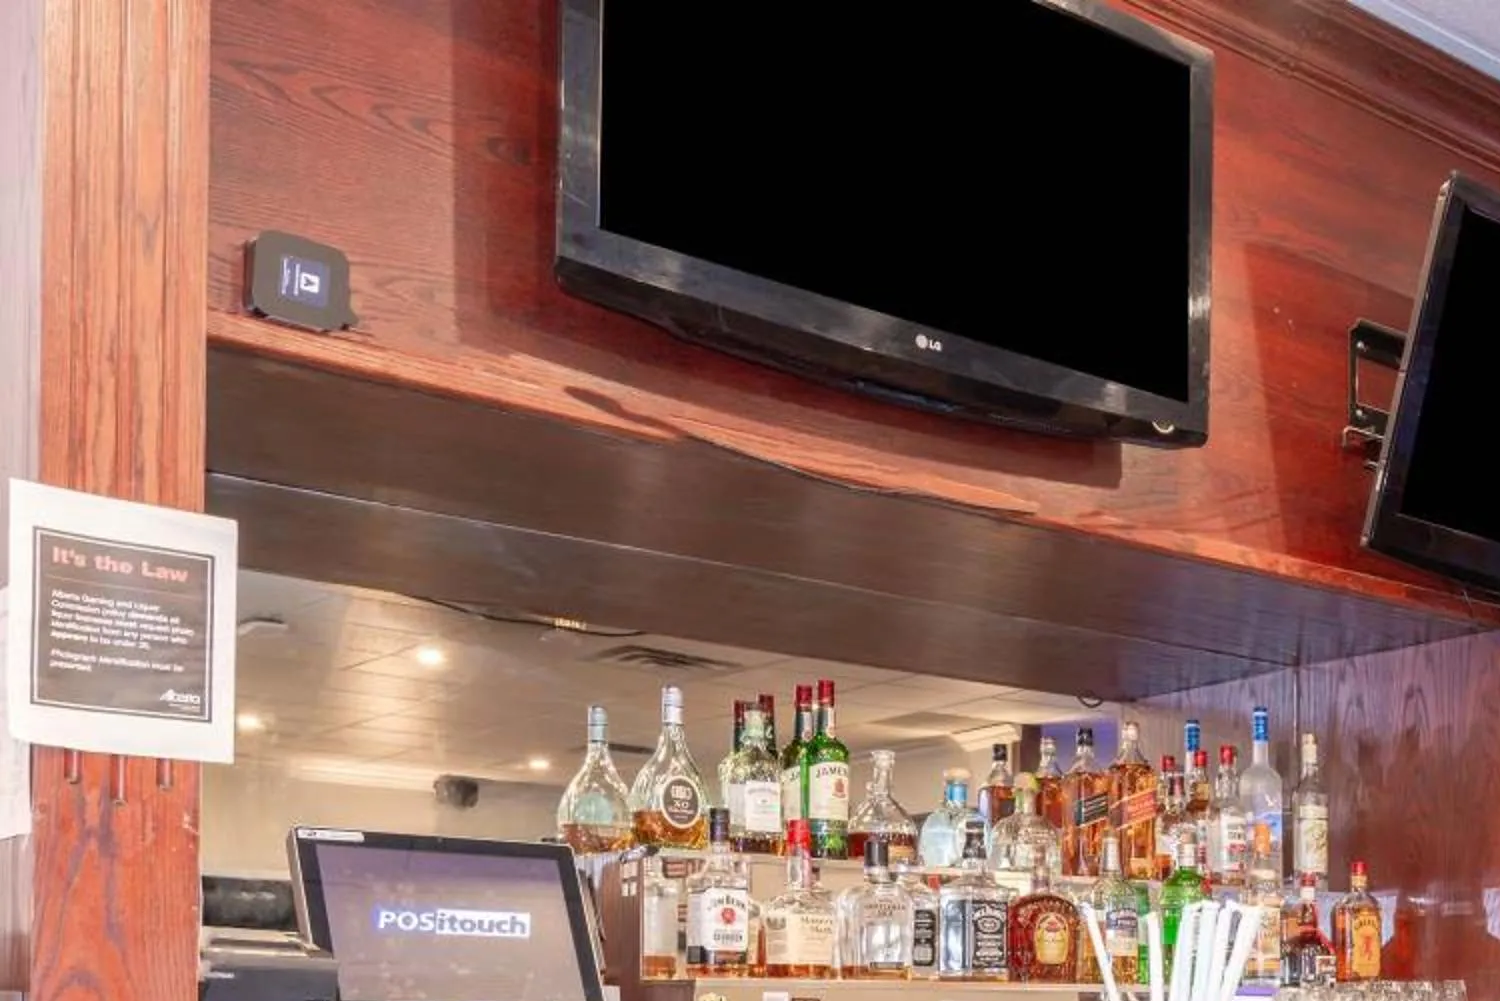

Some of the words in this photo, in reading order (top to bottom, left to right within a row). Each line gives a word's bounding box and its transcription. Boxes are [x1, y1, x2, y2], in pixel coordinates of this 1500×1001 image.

[52, 547, 87, 567] It's
[94, 555, 133, 575] the
[141, 561, 188, 582] Law
[377, 909, 527, 936] POSitouch
